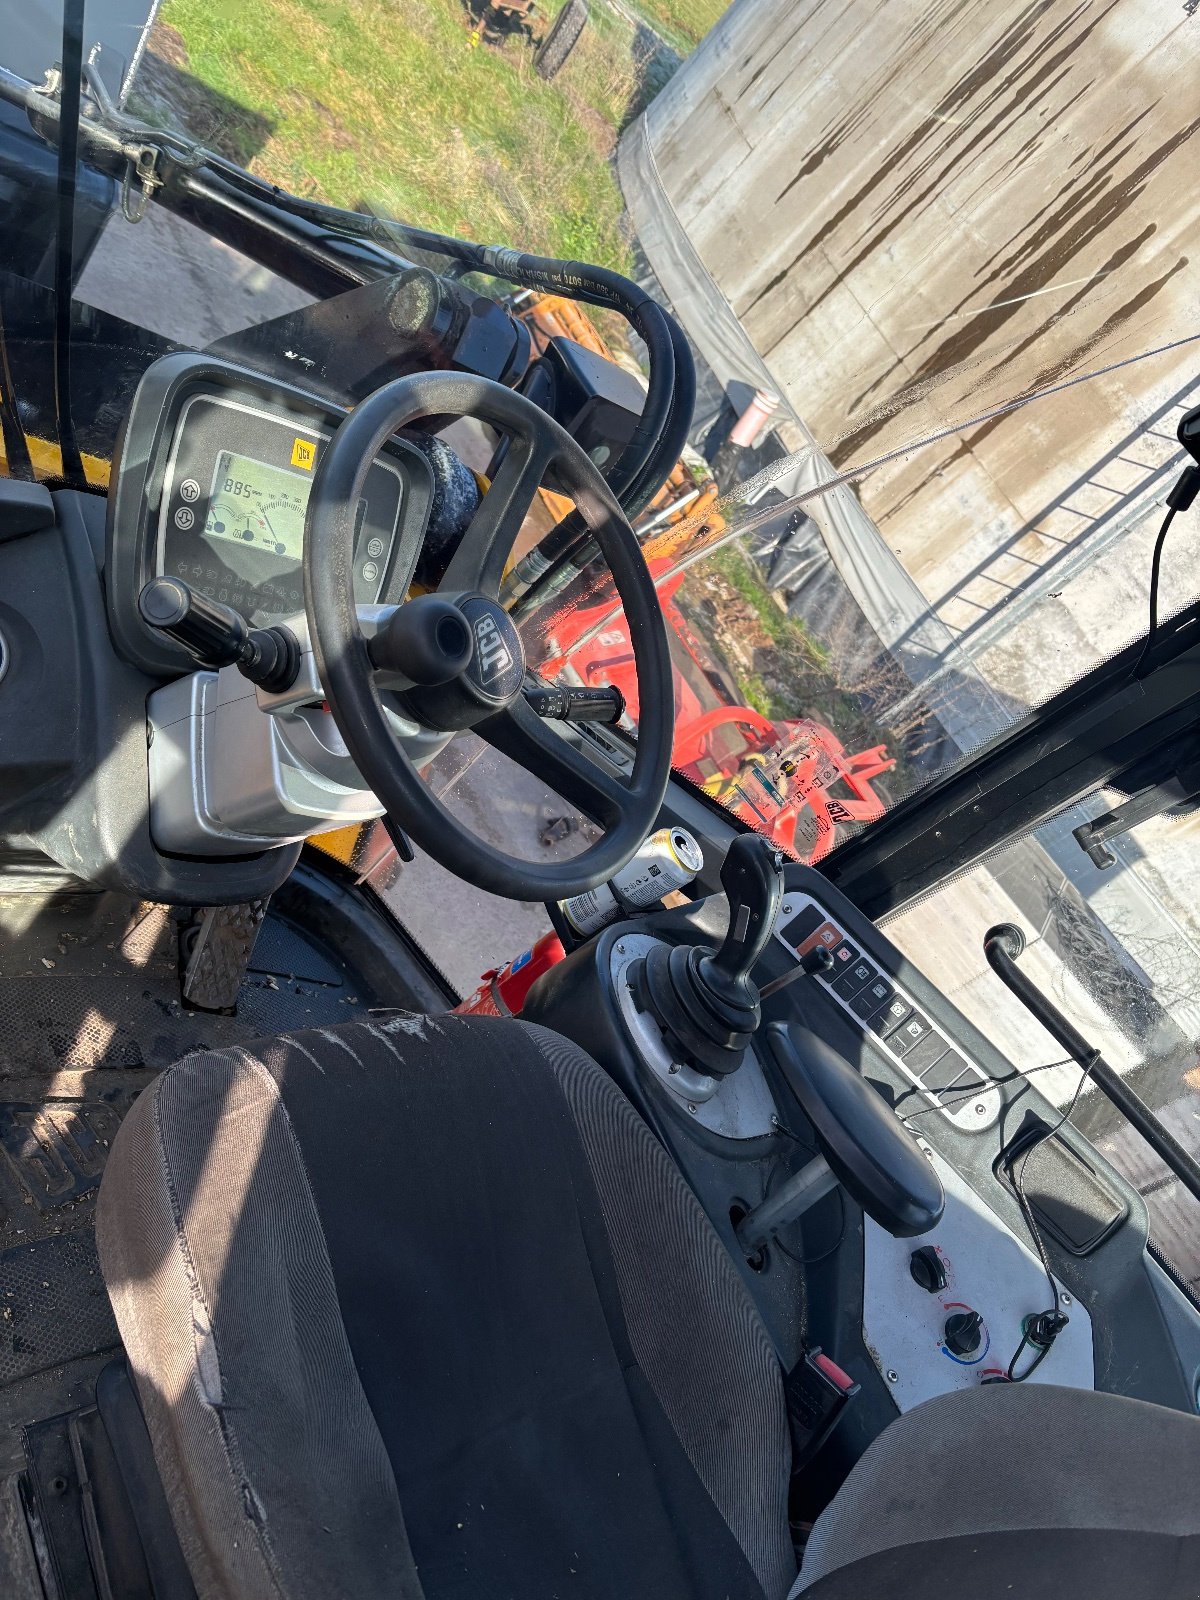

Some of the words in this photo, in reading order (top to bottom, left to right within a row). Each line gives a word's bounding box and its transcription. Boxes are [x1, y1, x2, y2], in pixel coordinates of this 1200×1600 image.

[550, 273, 562, 283] psi
[224, 478, 252, 498] 885
[477, 617, 509, 672] JCB
[826, 801, 852, 823] JCB
